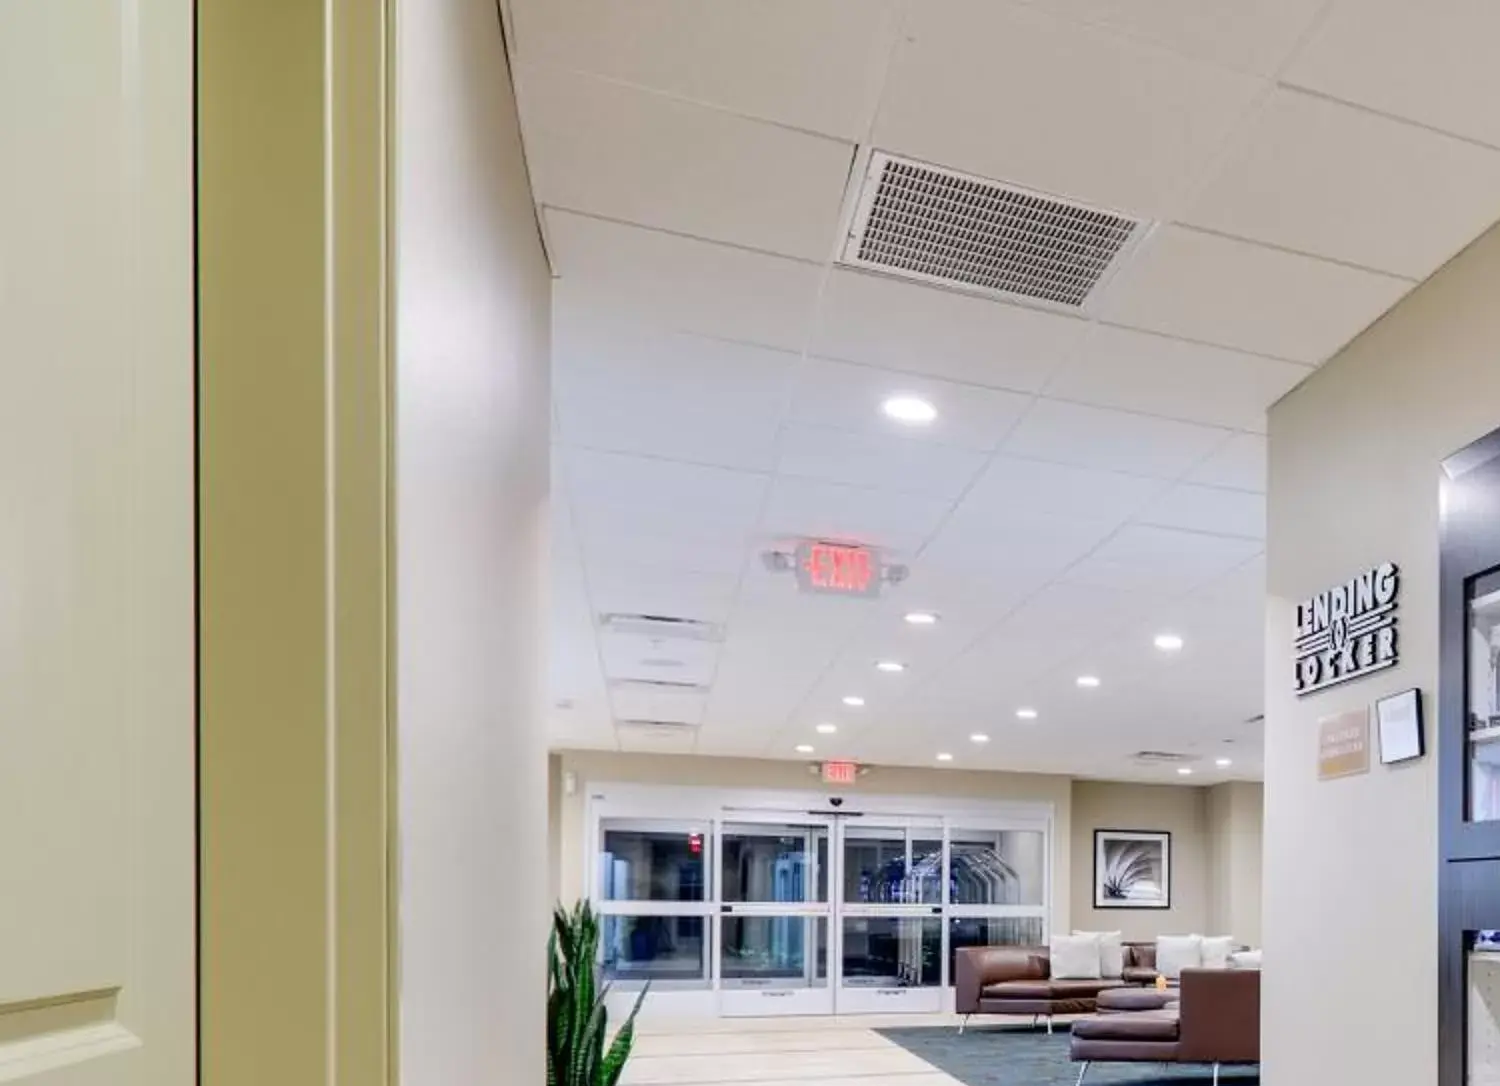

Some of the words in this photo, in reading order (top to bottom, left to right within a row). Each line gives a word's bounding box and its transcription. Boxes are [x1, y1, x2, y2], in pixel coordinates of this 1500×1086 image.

[811, 547, 870, 592] EXIT
[1297, 562, 1399, 635] LENDING
[1294, 626, 1399, 690] LOCKER
